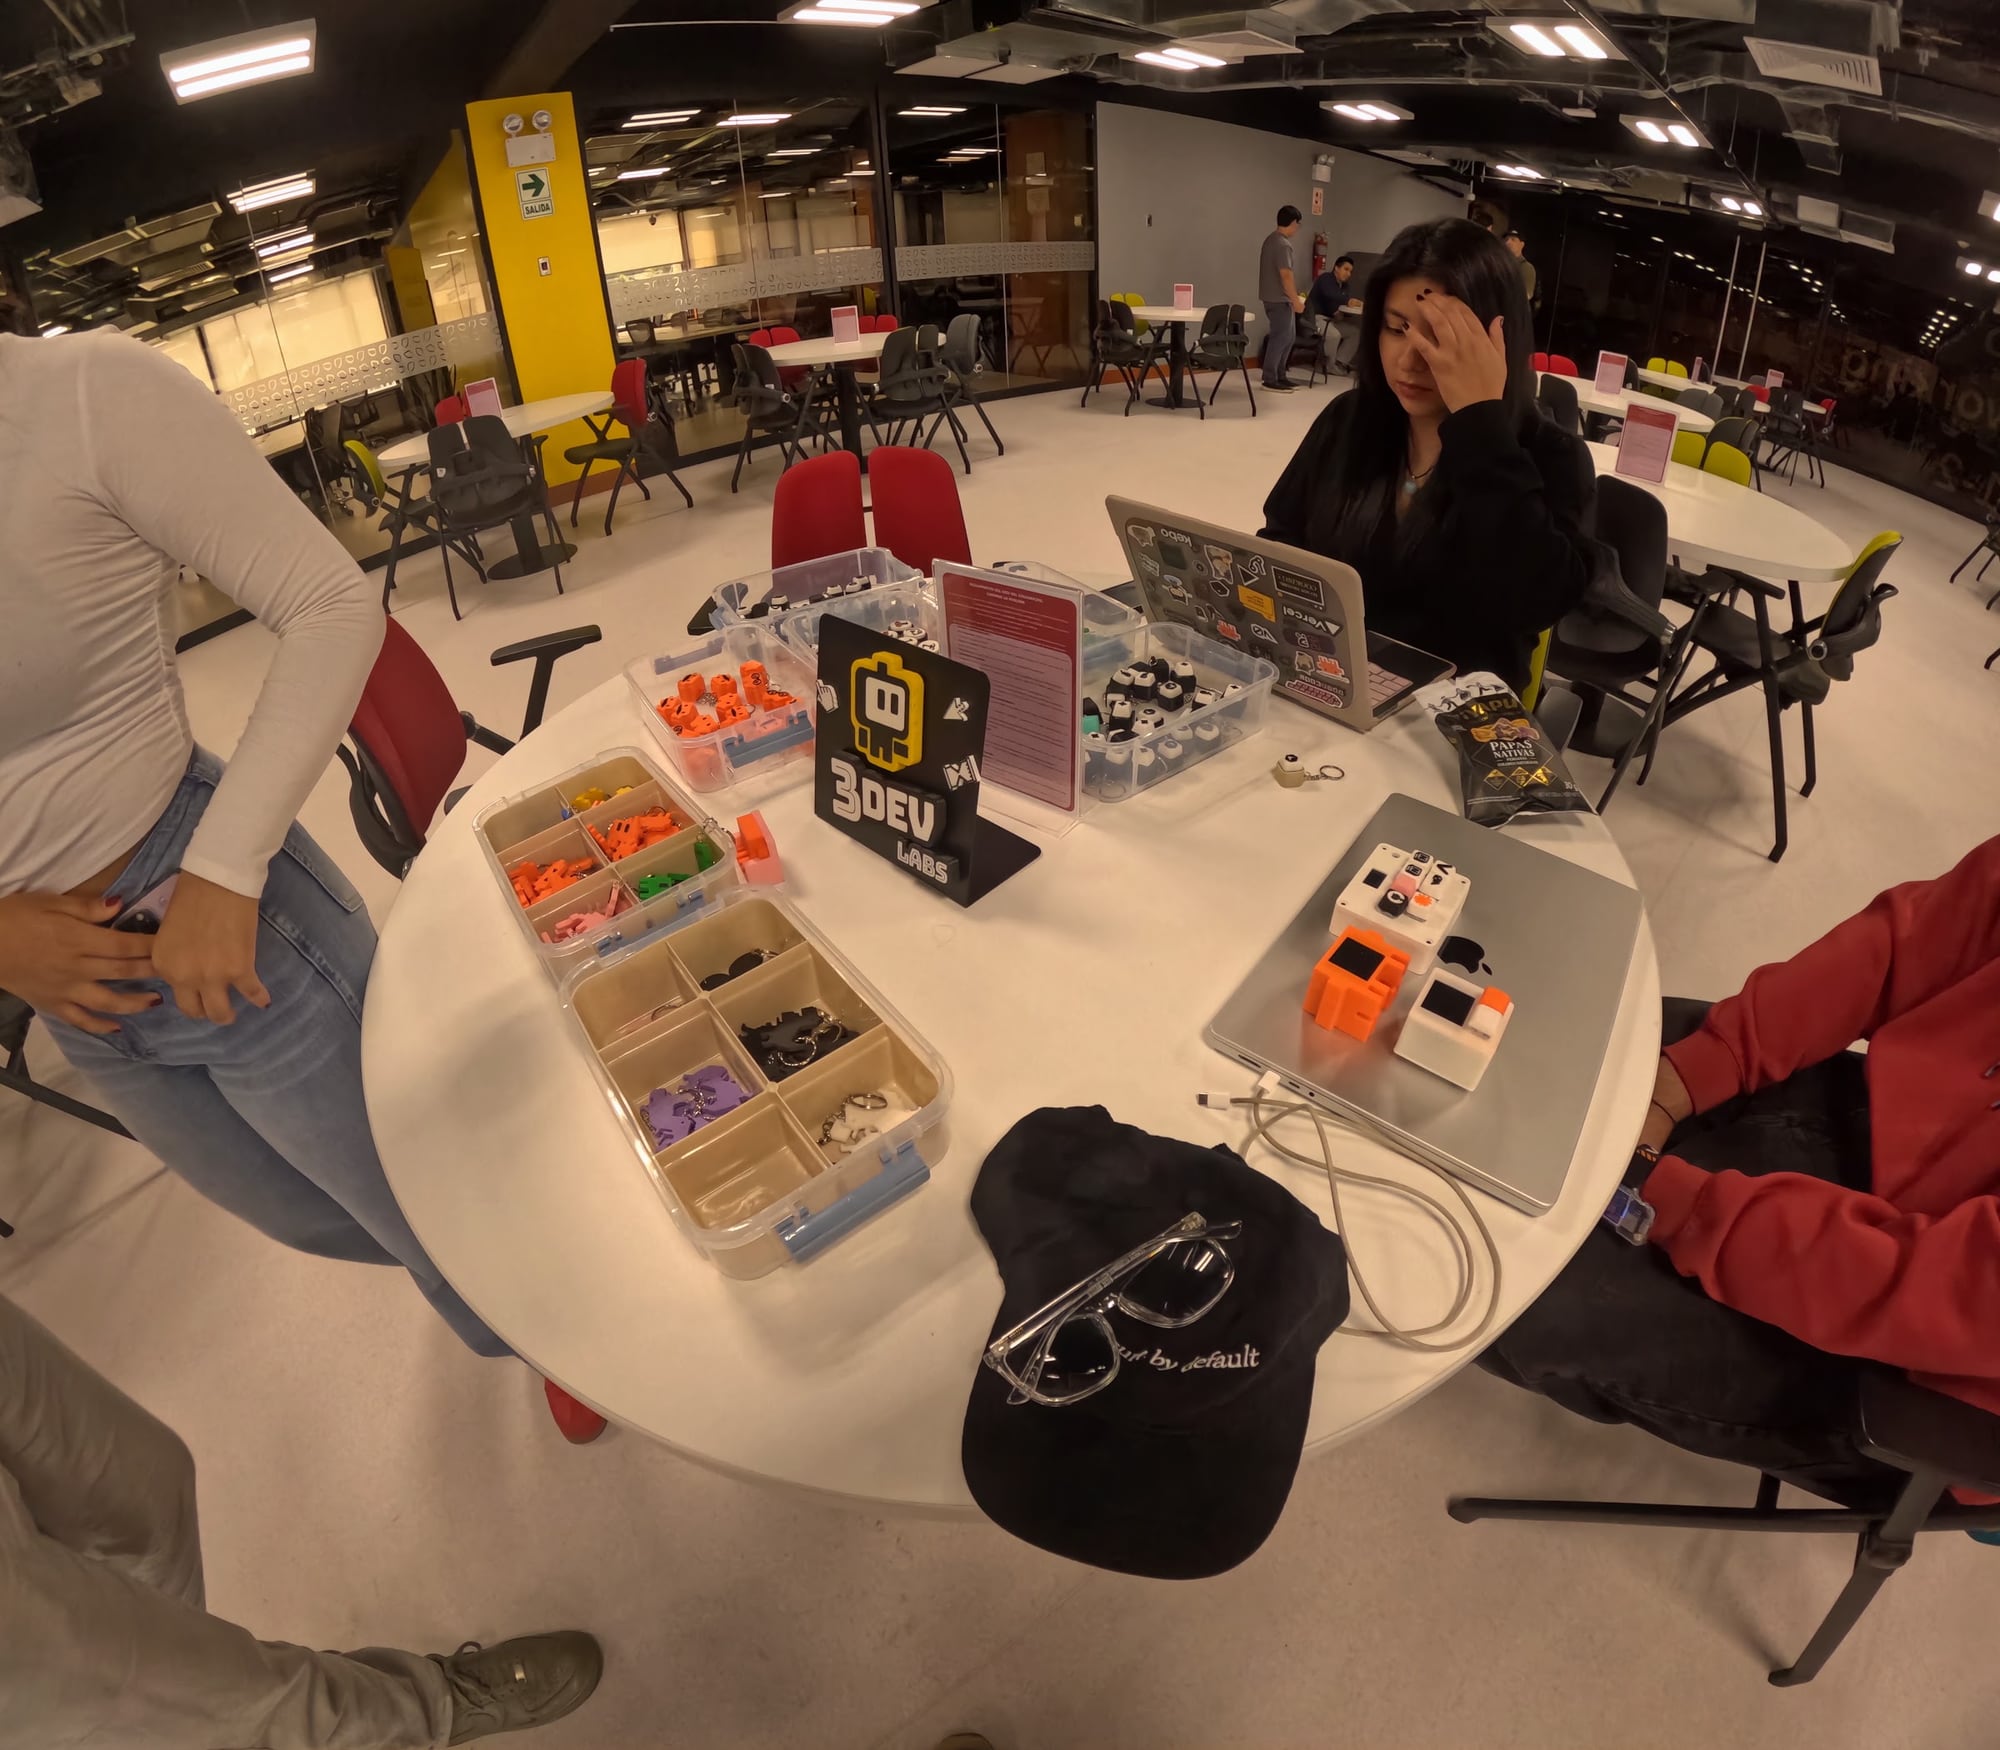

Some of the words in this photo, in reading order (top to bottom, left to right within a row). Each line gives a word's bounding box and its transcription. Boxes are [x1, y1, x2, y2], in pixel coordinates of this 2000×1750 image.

[525, 203, 550, 214] SALIDA
[1161, 527, 1193, 547] kebo
[1283, 604, 1328, 634] Vercel
[1490, 740, 1532, 751] PAPAS
[1493, 749, 1536, 759] NATIVAS
[831, 757, 935, 842] 3DEV
[897, 840, 948, 884] LABS
[1150, 1348, 1178, 1371] by
[1181, 1343, 1260, 1373] default
